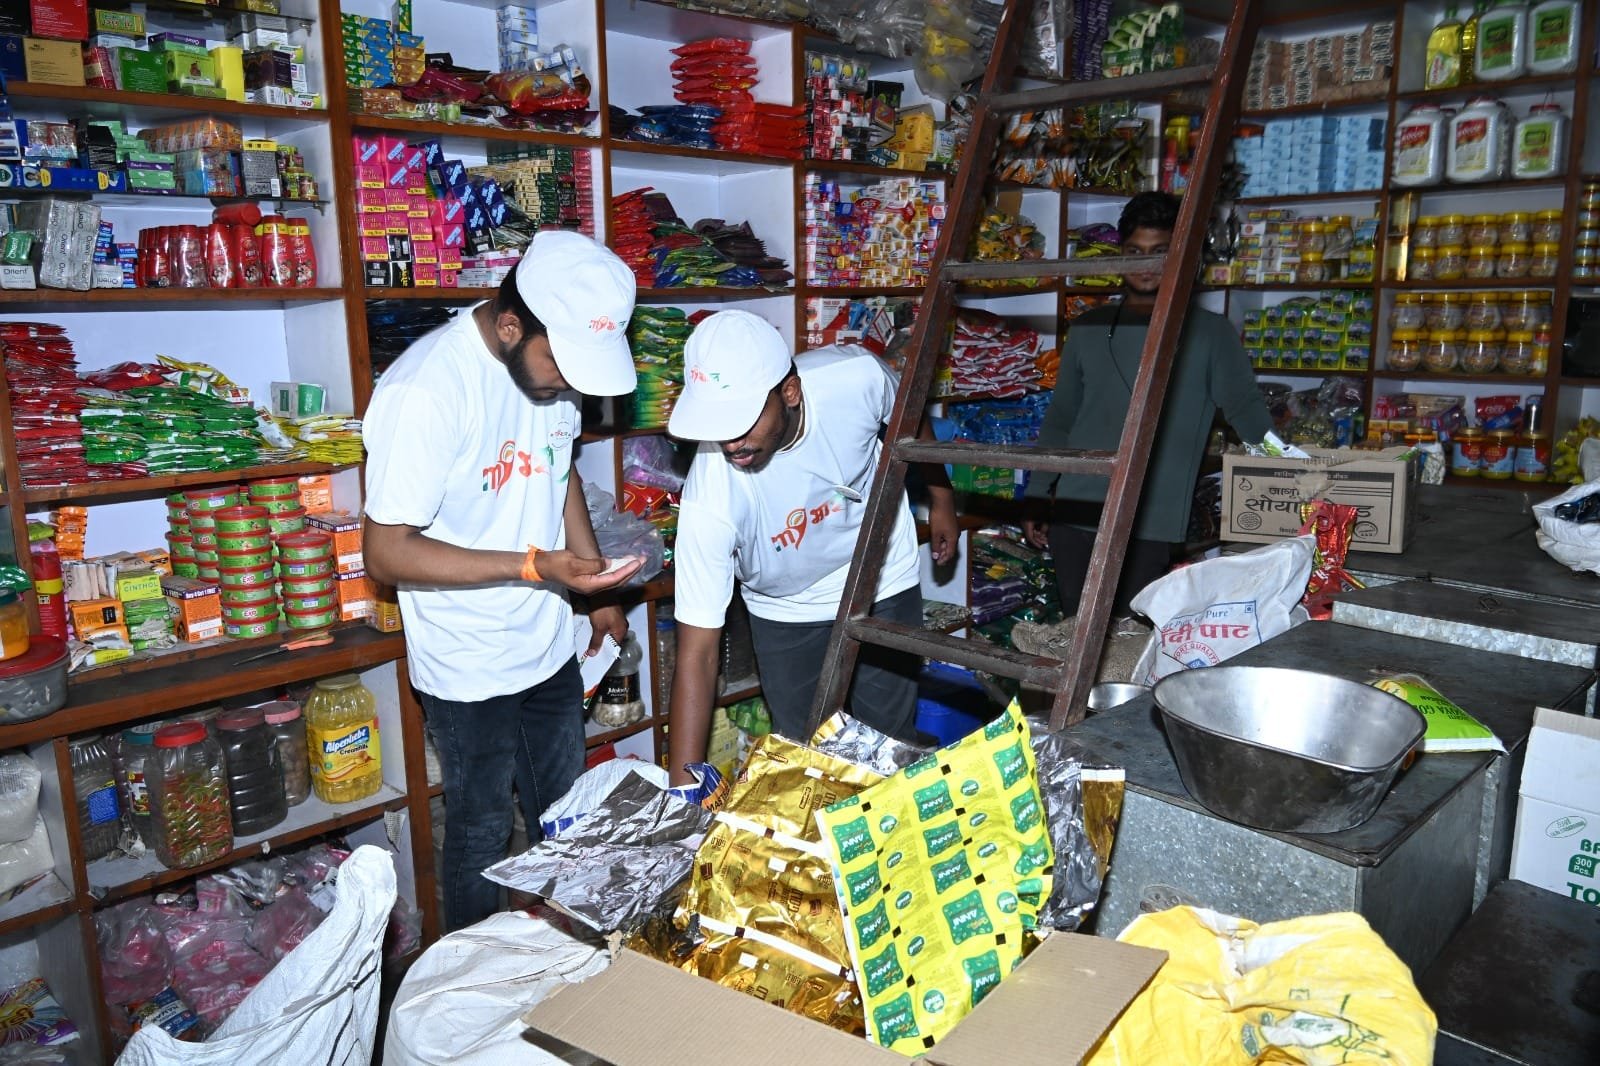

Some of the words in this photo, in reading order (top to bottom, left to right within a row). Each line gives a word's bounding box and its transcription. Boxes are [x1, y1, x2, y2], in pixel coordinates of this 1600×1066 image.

[65, 570, 74, 589] LUX
[123, 581, 159, 593] CINTHOL
[1206, 609, 1229, 619] Pure
[1199, 623, 1250, 639] पाट
[325, 728, 367, 753] Alpenliebe
[1575, 856, 1592, 868] 300
[1573, 865, 1592, 876] Pcs.
[953, 908, 977, 928] ANNI
[881, 1012, 907, 1031] ANNI
